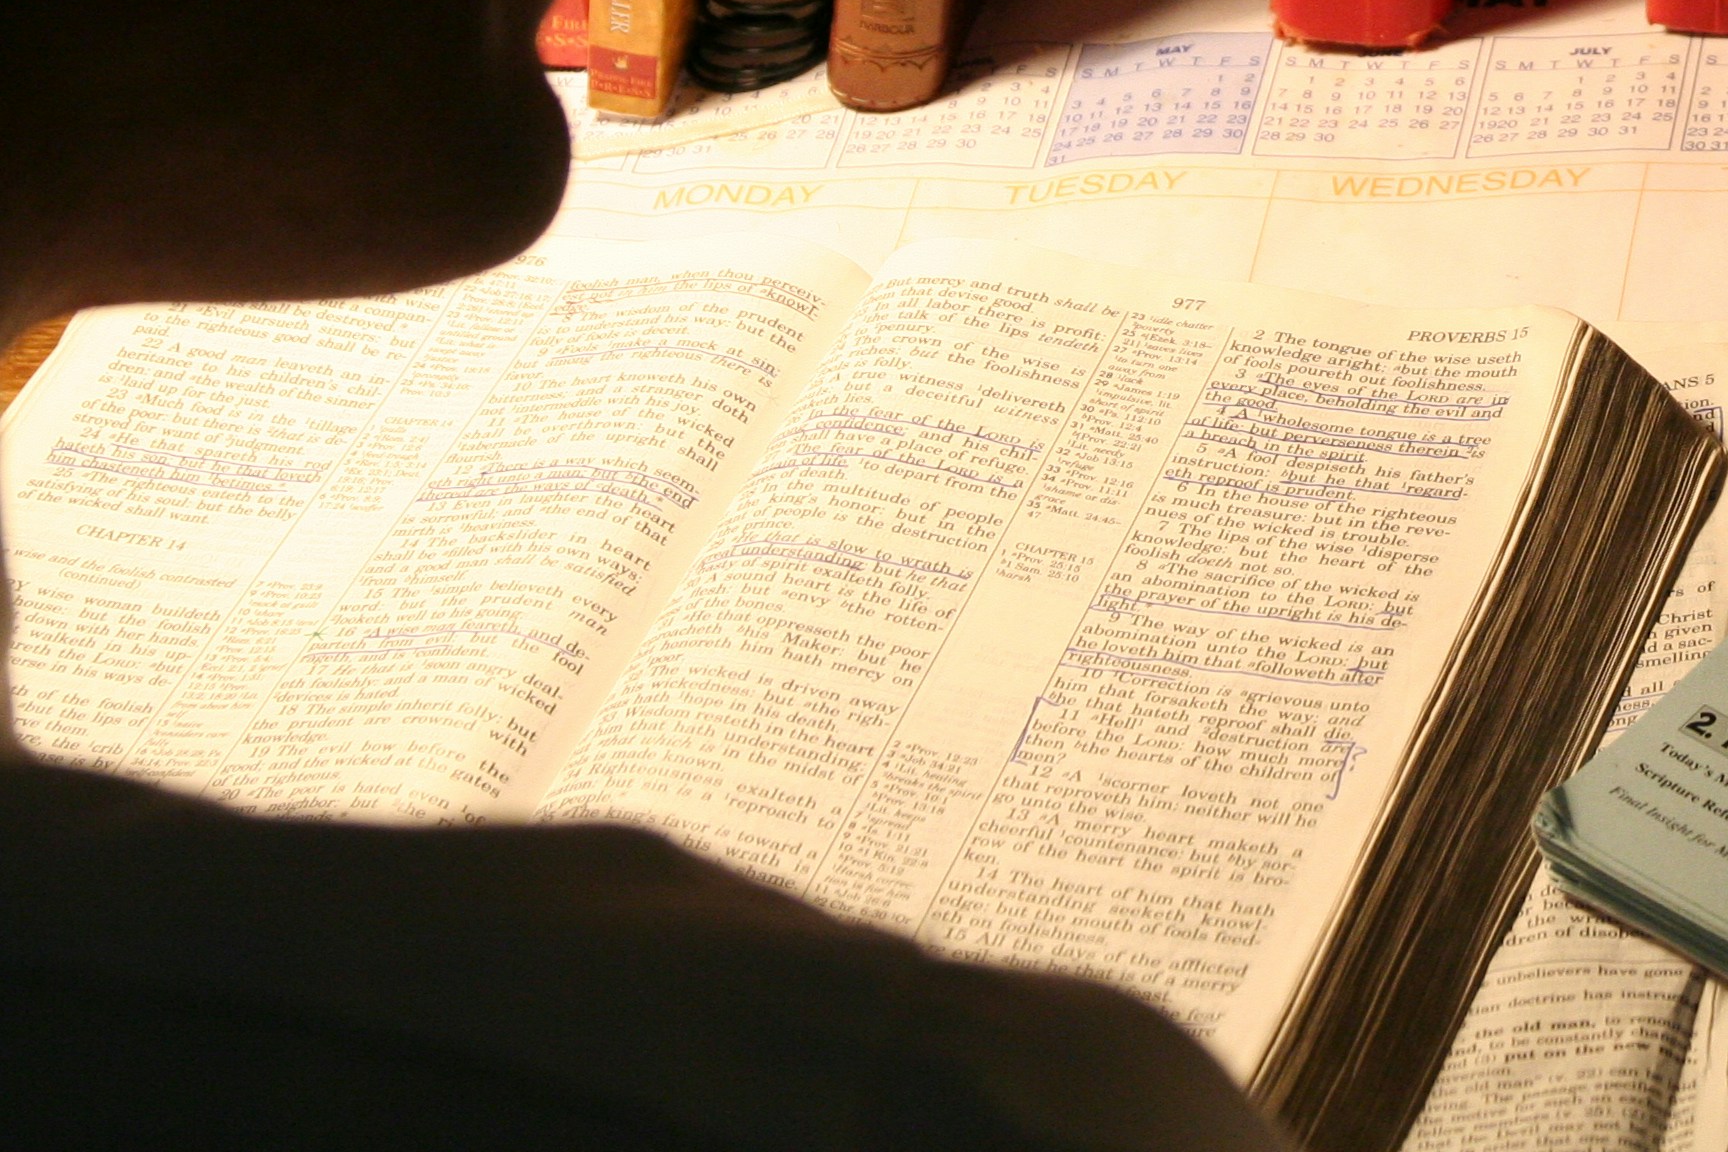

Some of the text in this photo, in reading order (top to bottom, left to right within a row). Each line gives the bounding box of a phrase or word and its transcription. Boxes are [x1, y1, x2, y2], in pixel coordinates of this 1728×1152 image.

[1568, 46, 1614, 58] JULY
[653, 184, 824, 210] MONDAY
[1005, 170, 1188, 206] TUESDAY
[1330, 167, 1592, 199] WEDNESDAY
[1171, 297, 1207, 311] 977
[1406, 326, 1529, 344] PROVERBS 15
[1657, 609, 1713, 625] Christ
[1686, 711, 1717, 739] 2.
[1660, 741, 1714, 778] Today's
[1635, 762, 1700, 803] Scripture
[1609, 785, 1647, 812] Final
[1646, 806, 1694, 837] Insight
[1688, 831, 1718, 849] for
